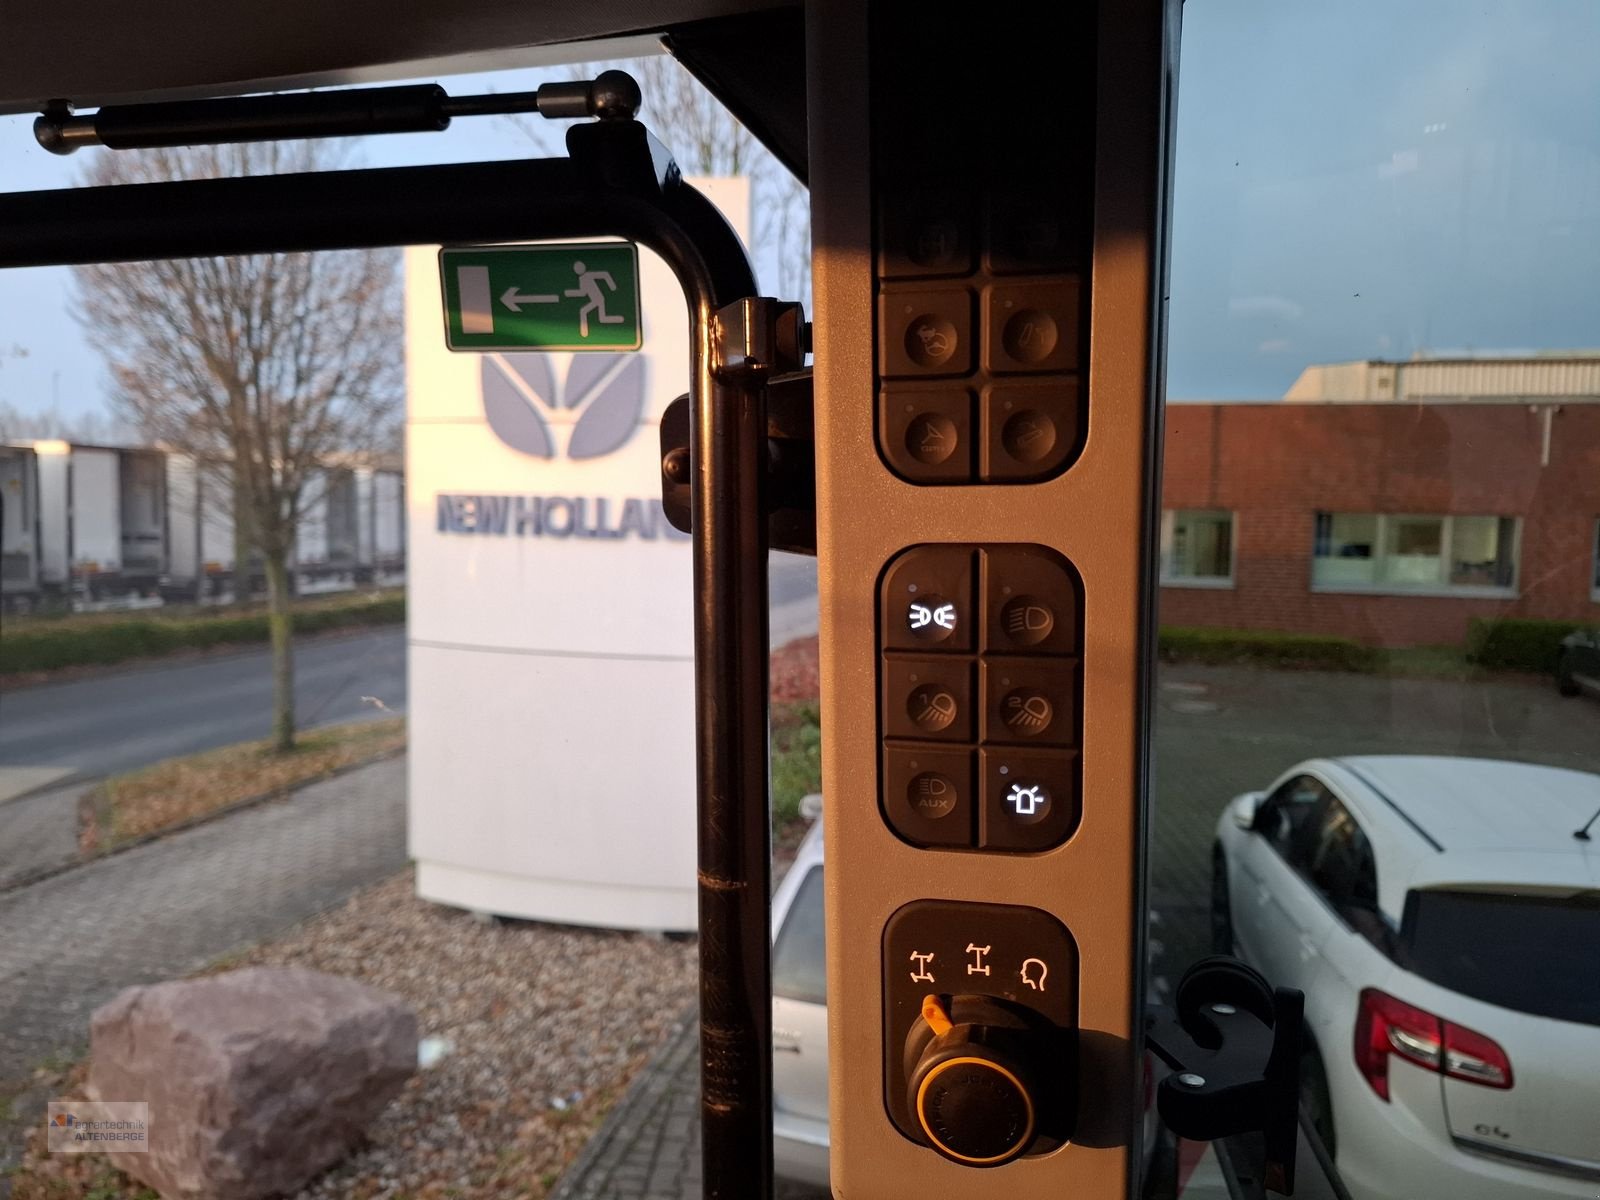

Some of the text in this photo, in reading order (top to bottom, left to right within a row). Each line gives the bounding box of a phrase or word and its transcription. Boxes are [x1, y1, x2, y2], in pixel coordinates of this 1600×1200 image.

[515, 496, 692, 541] HOLLAN
[919, 693, 928, 705] 1
[1007, 696, 1022, 708] 2
[918, 799, 948, 809] AUX
